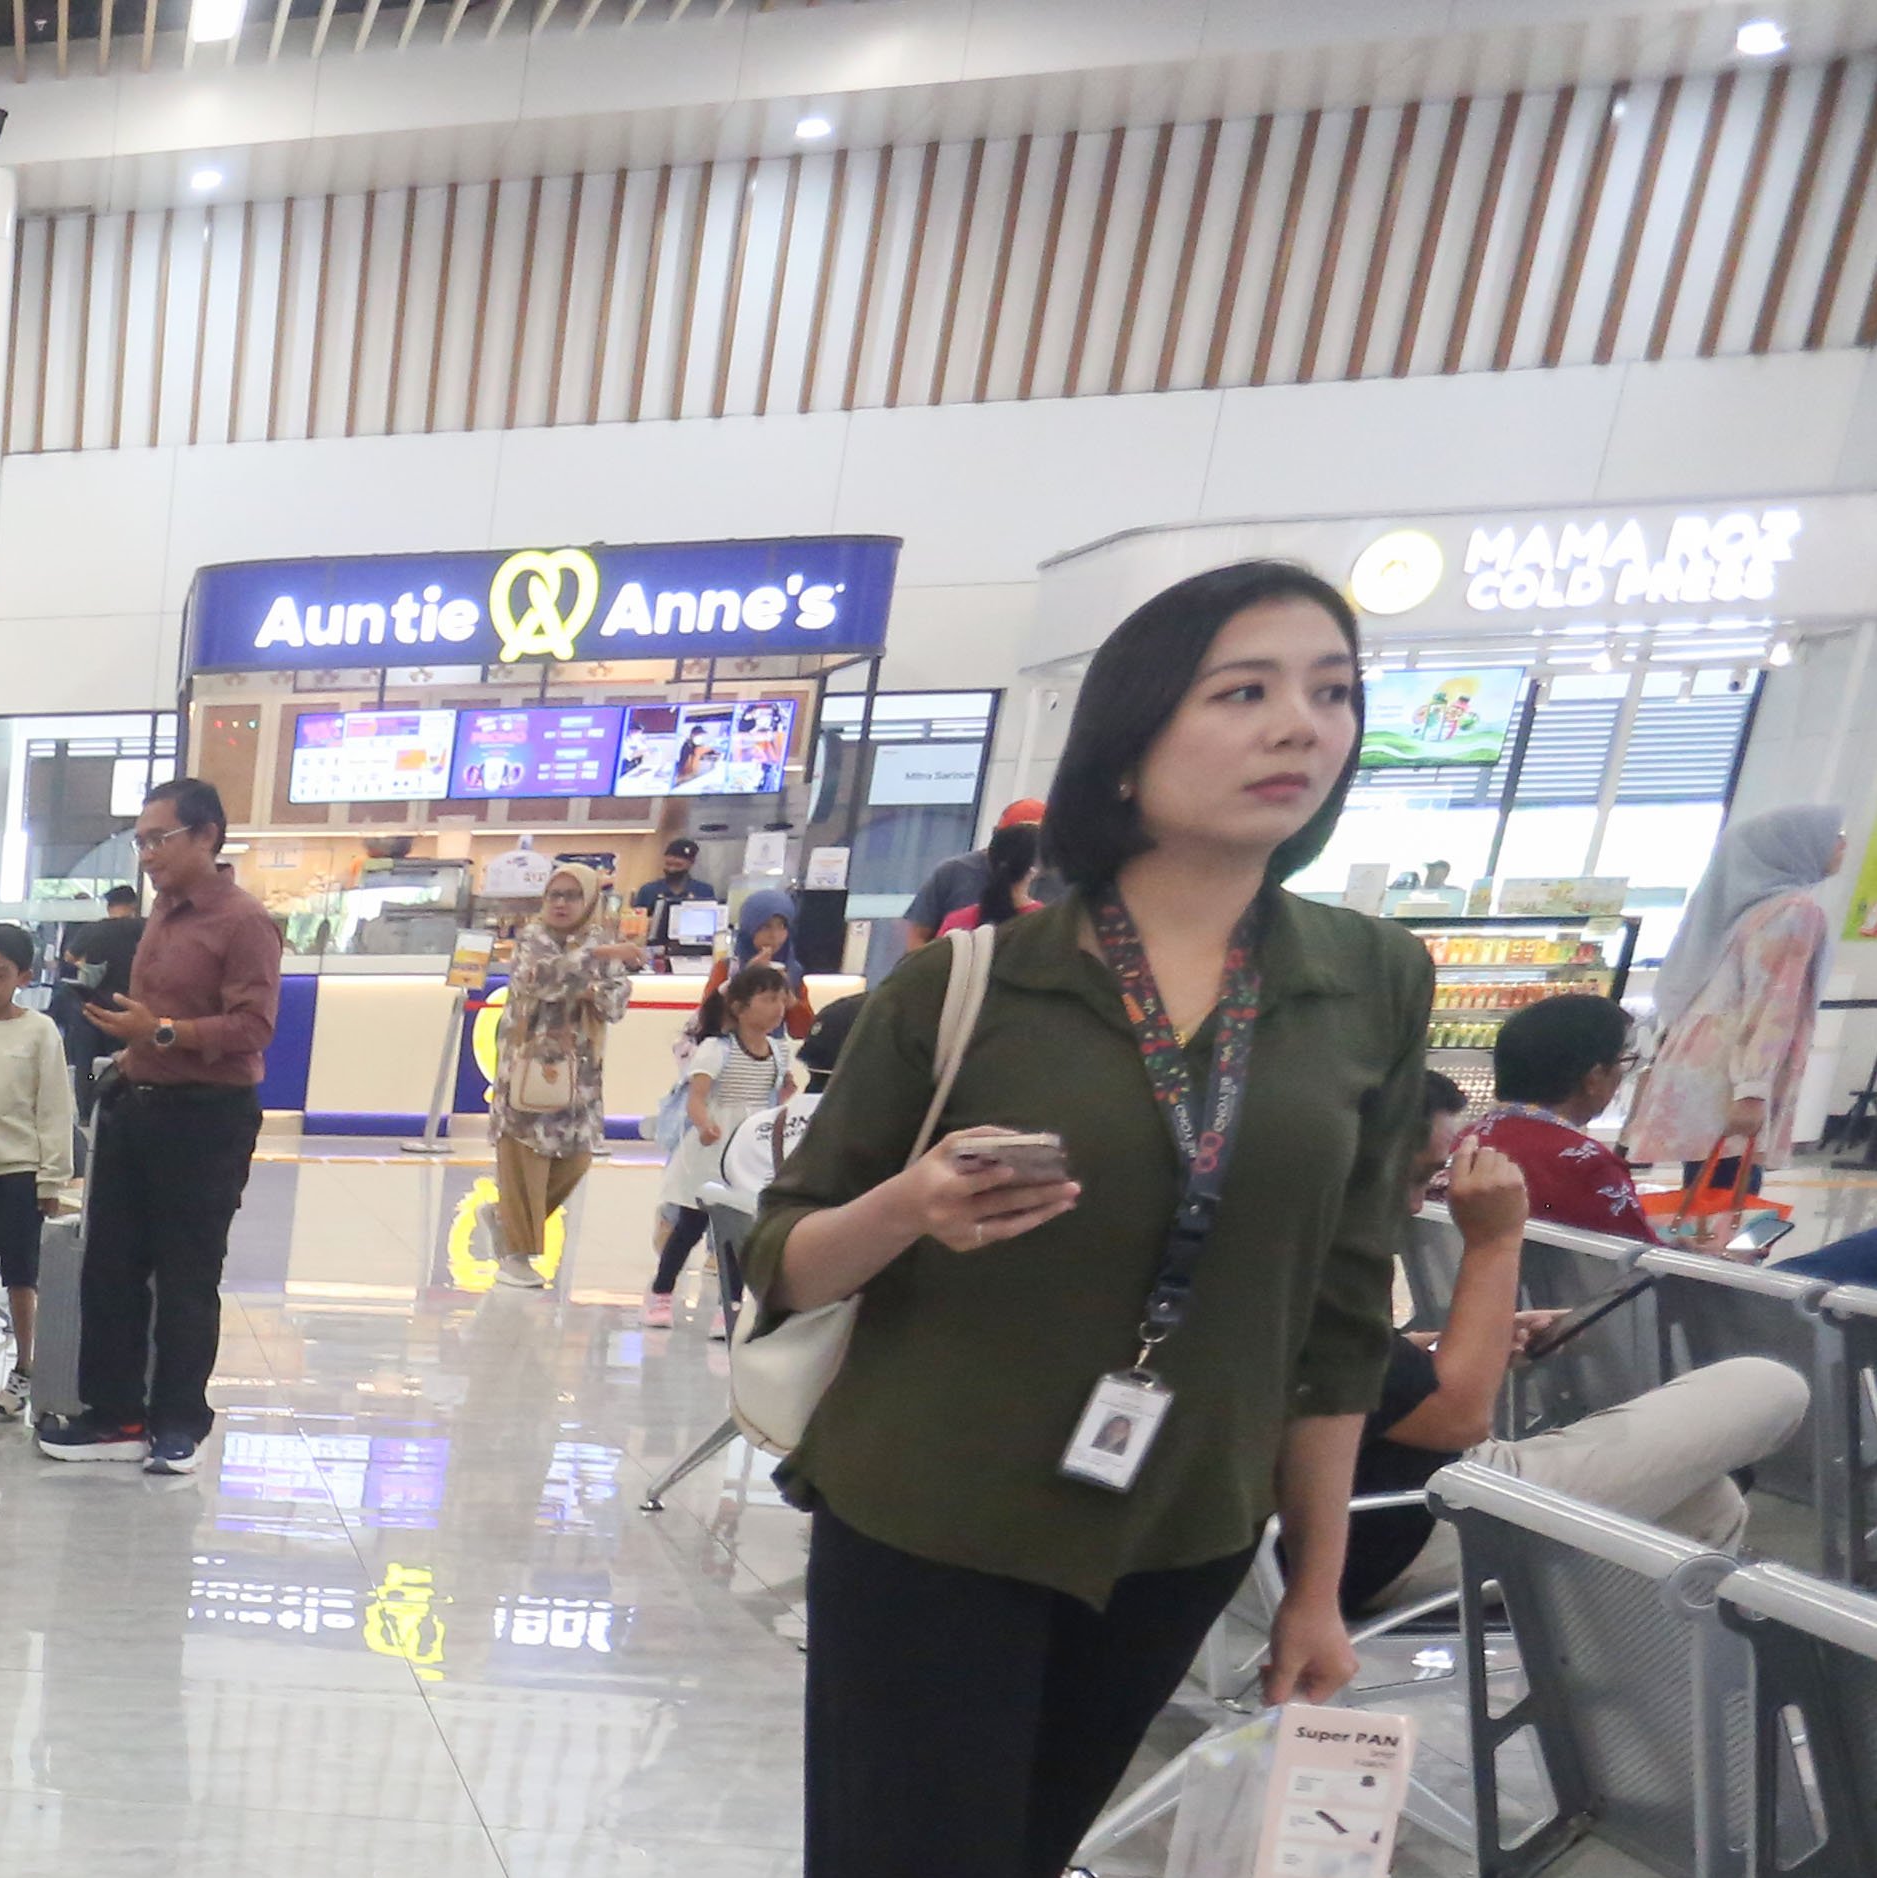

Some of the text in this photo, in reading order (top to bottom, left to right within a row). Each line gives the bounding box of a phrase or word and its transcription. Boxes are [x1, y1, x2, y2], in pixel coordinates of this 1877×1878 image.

[1464, 508, 1803, 575] MAMA ROZ
[253, 574, 840, 649] Auntie Anne's
[1466, 559, 1777, 611] COLD PRESS
[1295, 1725, 1400, 1747] Super PAN
